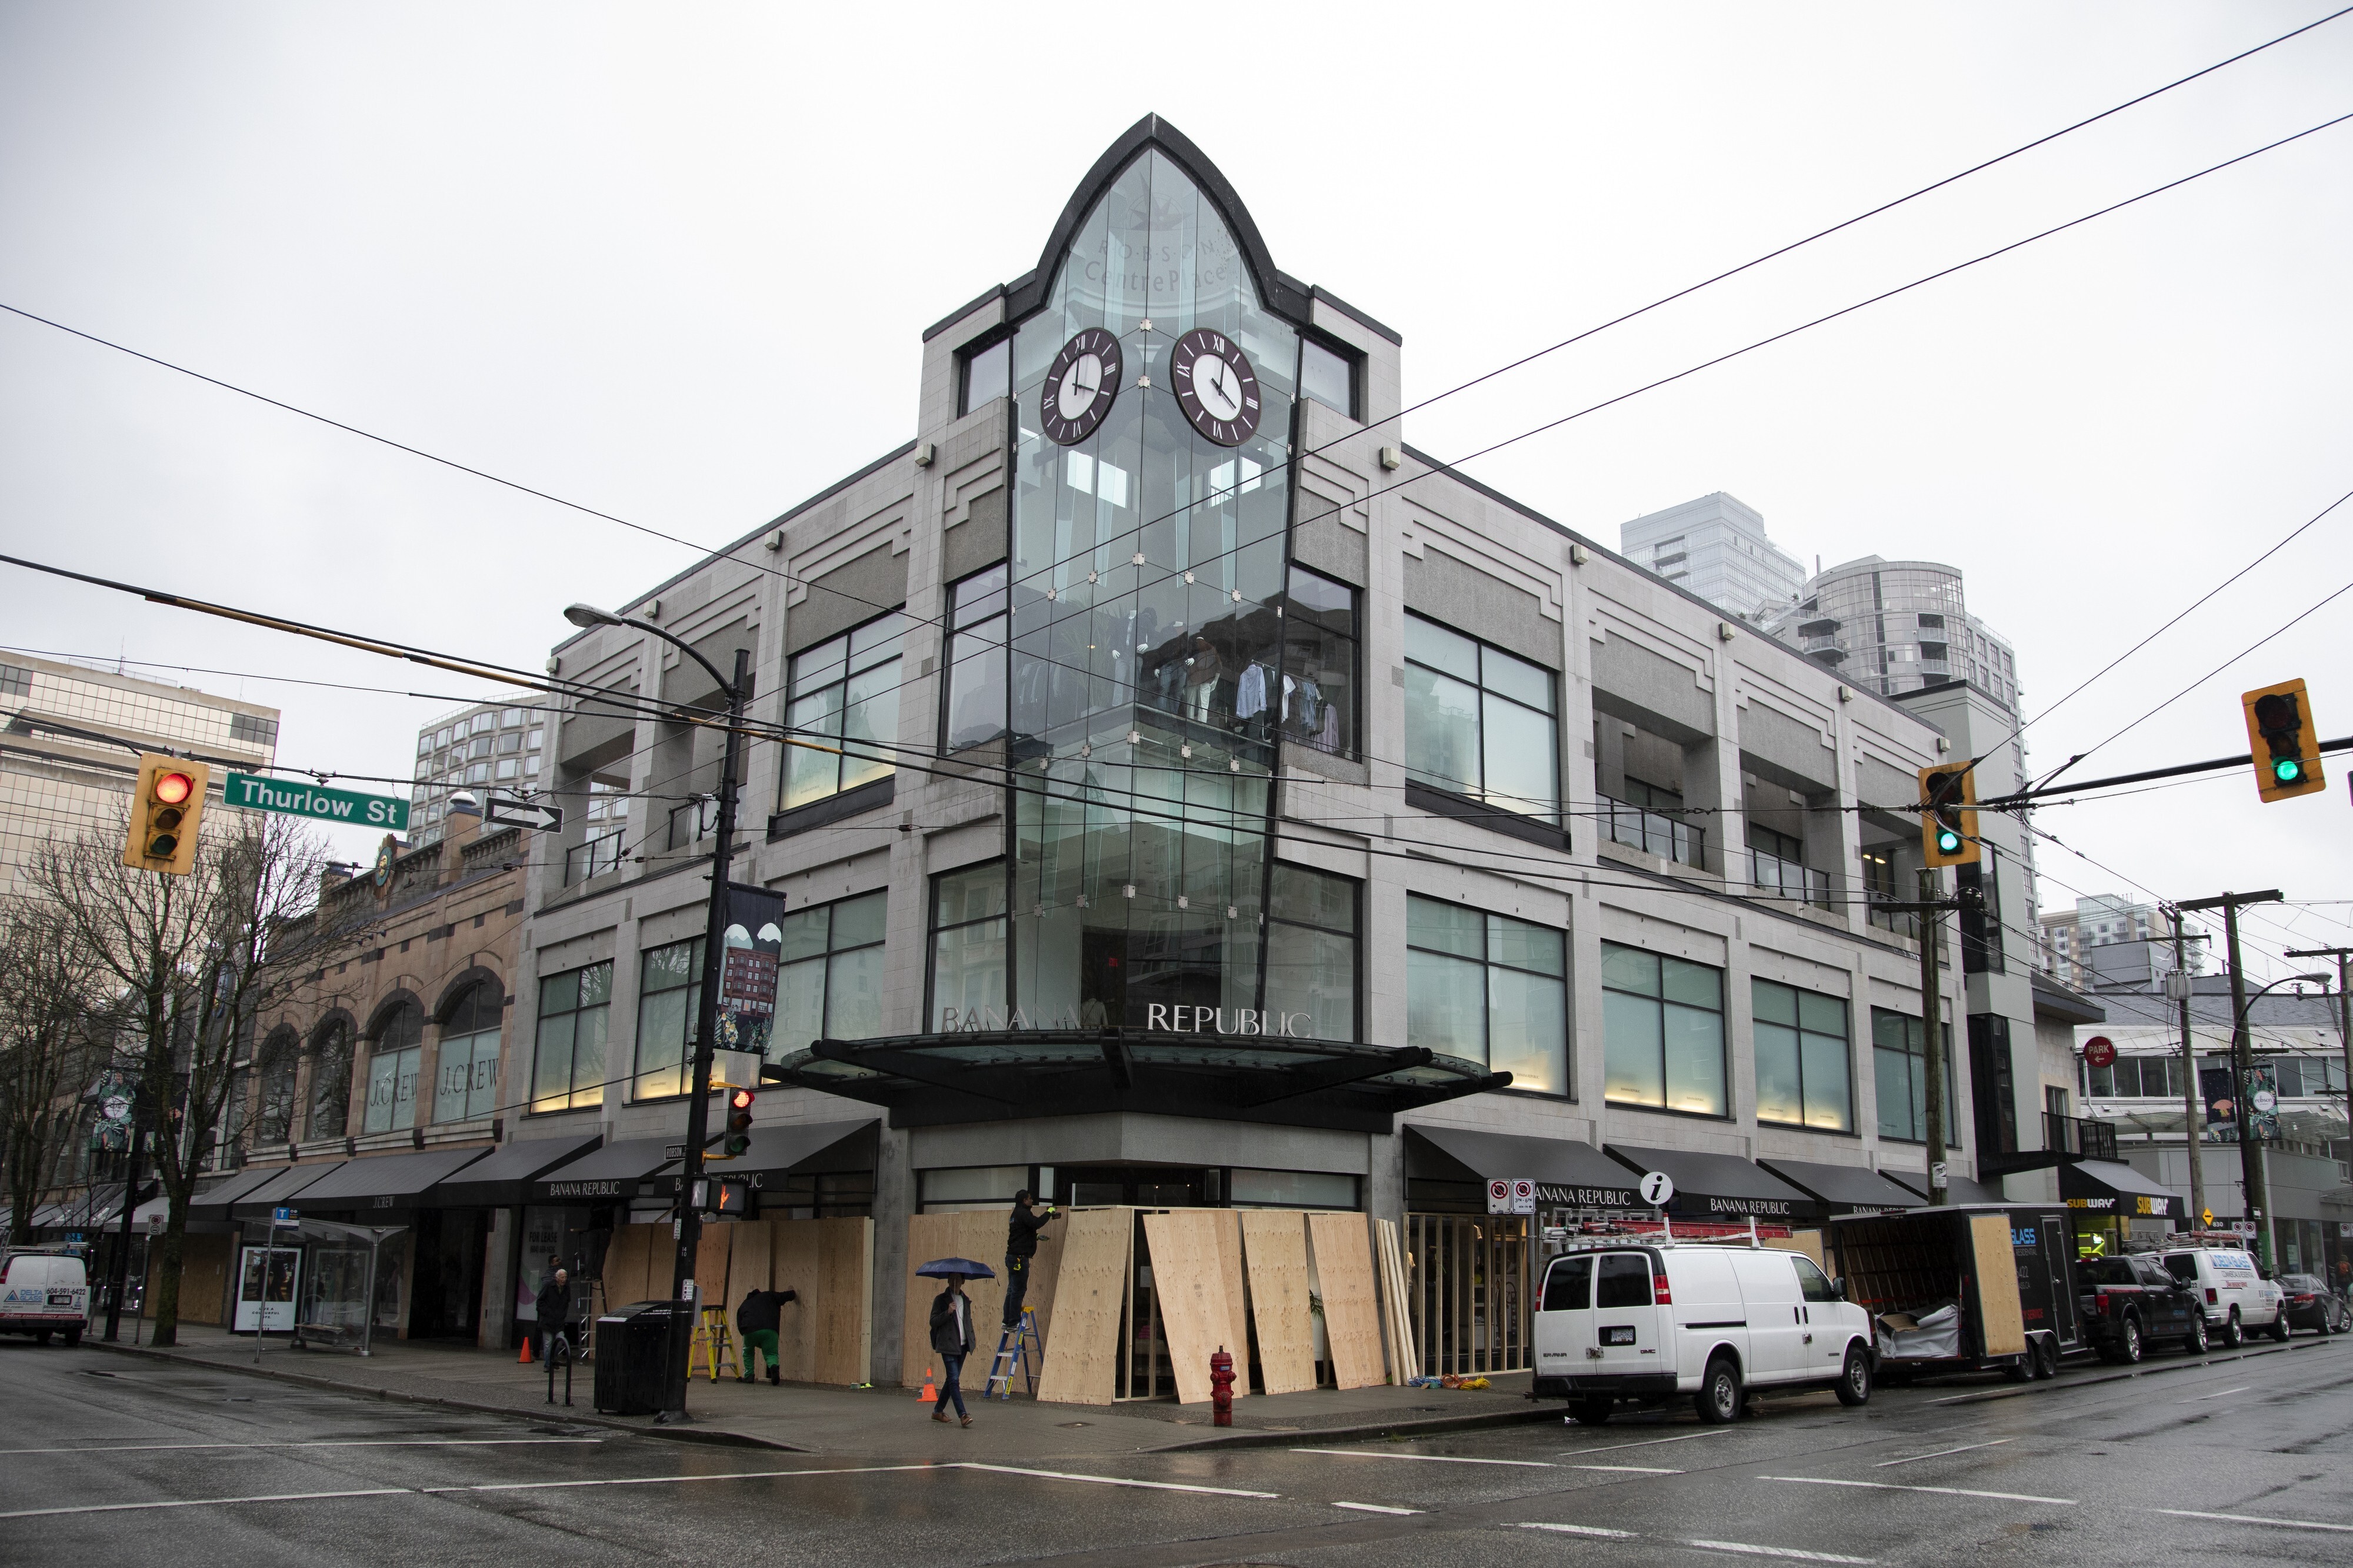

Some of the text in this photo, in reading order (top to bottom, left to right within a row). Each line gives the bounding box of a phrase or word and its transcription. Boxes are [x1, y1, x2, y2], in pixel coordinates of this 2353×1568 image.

[241, 780, 397, 824] Thurlow St
[941, 1003, 1311, 1039] BANANA REPUBLIC
[2088, 1045, 2109, 1055] PARK
[440, 1059, 499, 1095] J.CREW
[371, 1073, 419, 1106] J.CREW
[2255, 1095, 2273, 1103] robson
[666, 1147, 682, 1157] ROBSON
[551, 1182, 620, 1196] BANANA REPUBLIC
[1534, 1186, 1630, 1206] ANANA REPUBLIC
[373, 1196, 395, 1208] J.CREW
[1711, 1198, 1789, 1215] BANANA REPUBLIC
[2067, 1197, 2116, 1208] SUBWAY
[2137, 1196, 2168, 1215] SUBWAY
[279, 1209, 286, 1217] T
[529, 1232, 557, 1242] FOR LEASE
